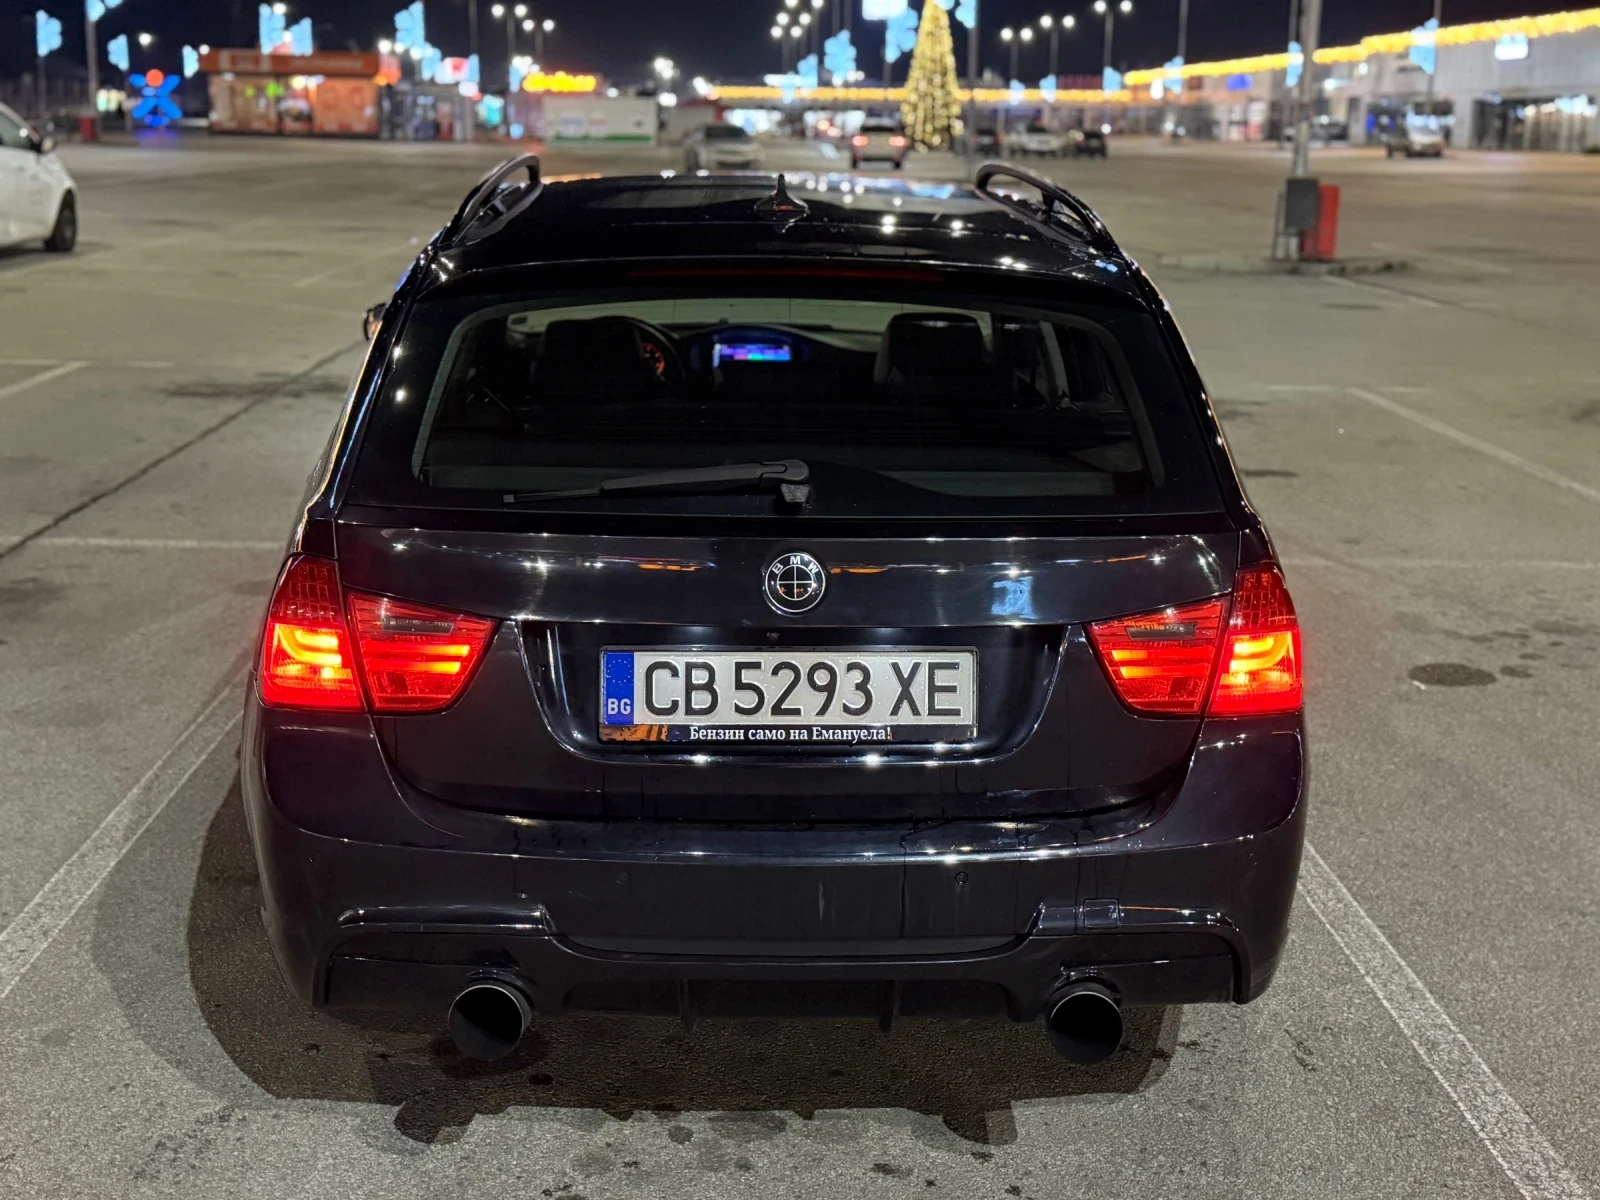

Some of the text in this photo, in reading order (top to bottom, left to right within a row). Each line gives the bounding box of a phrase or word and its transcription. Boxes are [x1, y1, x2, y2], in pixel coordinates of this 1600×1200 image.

[772, 555, 819, 575] BMW
[645, 660, 962, 716] CB 5293 XE
[607, 698, 631, 715] BG
[689, 726, 891, 744] Бензин само на Емануела!
